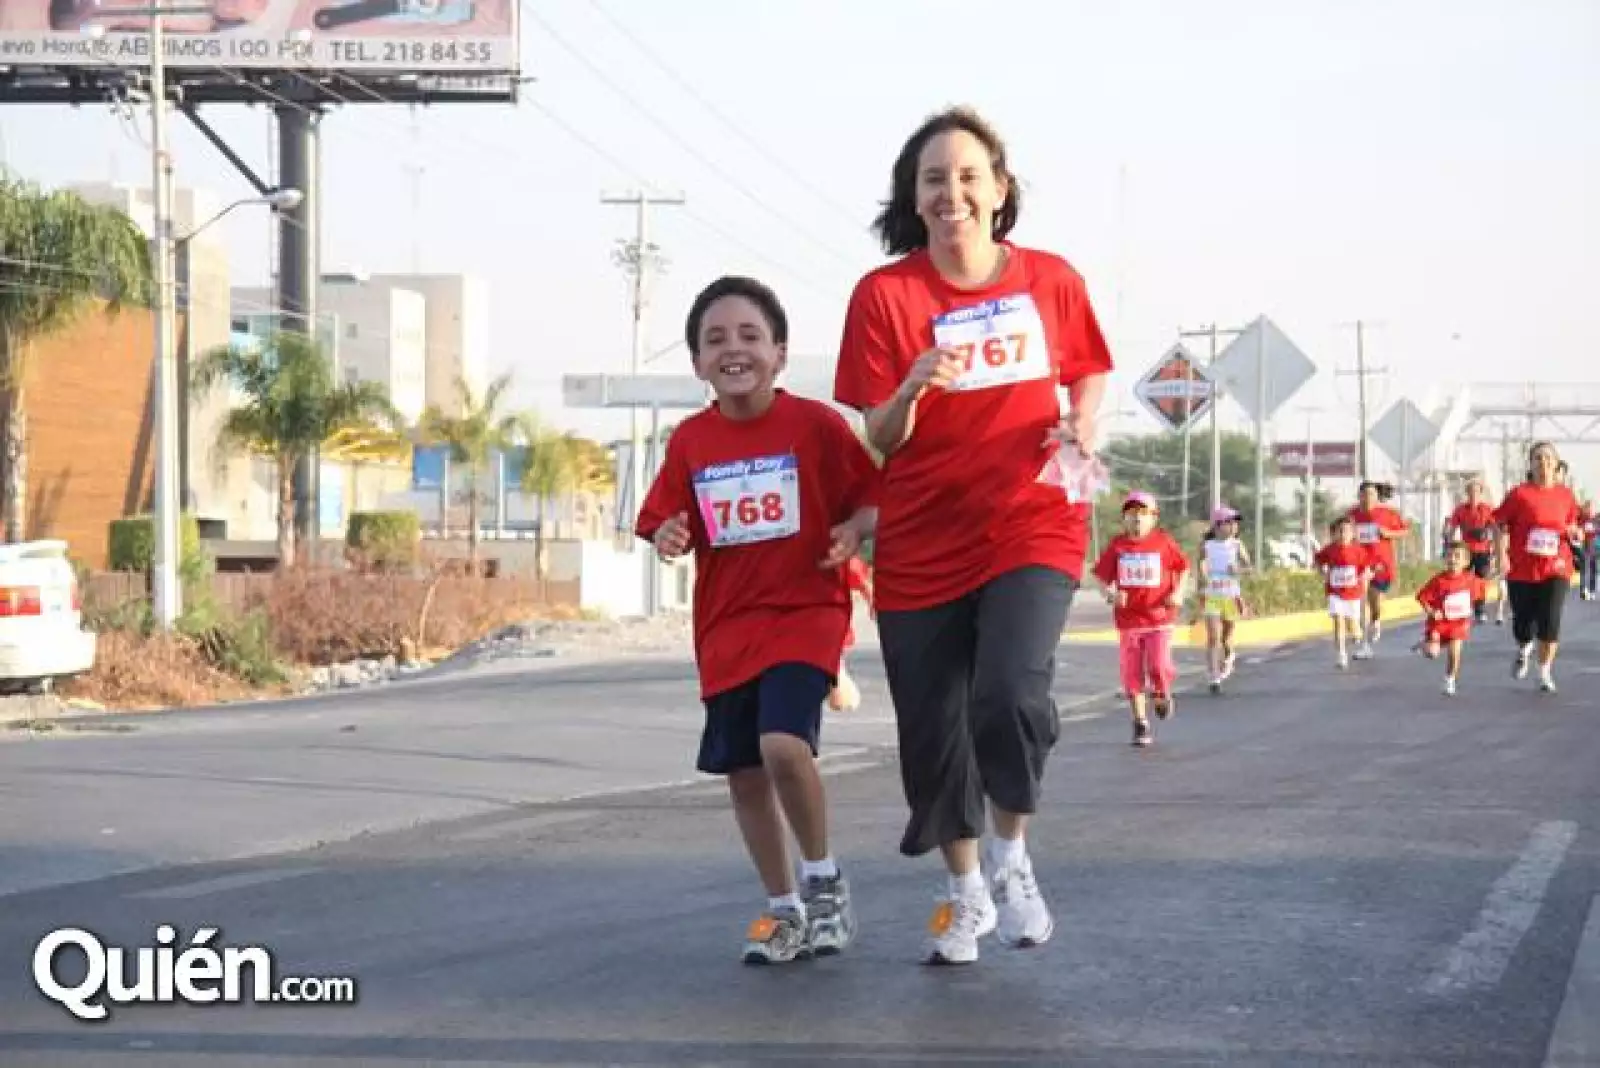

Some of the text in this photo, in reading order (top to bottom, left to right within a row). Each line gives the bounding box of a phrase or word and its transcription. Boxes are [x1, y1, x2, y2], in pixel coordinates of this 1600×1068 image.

[329, 40, 376, 61] TEL.
[383, 41, 426, 61] 218
[431, 41, 458, 61] 84
[954, 332, 1028, 373] 767
[712, 492, 785, 529] 768
